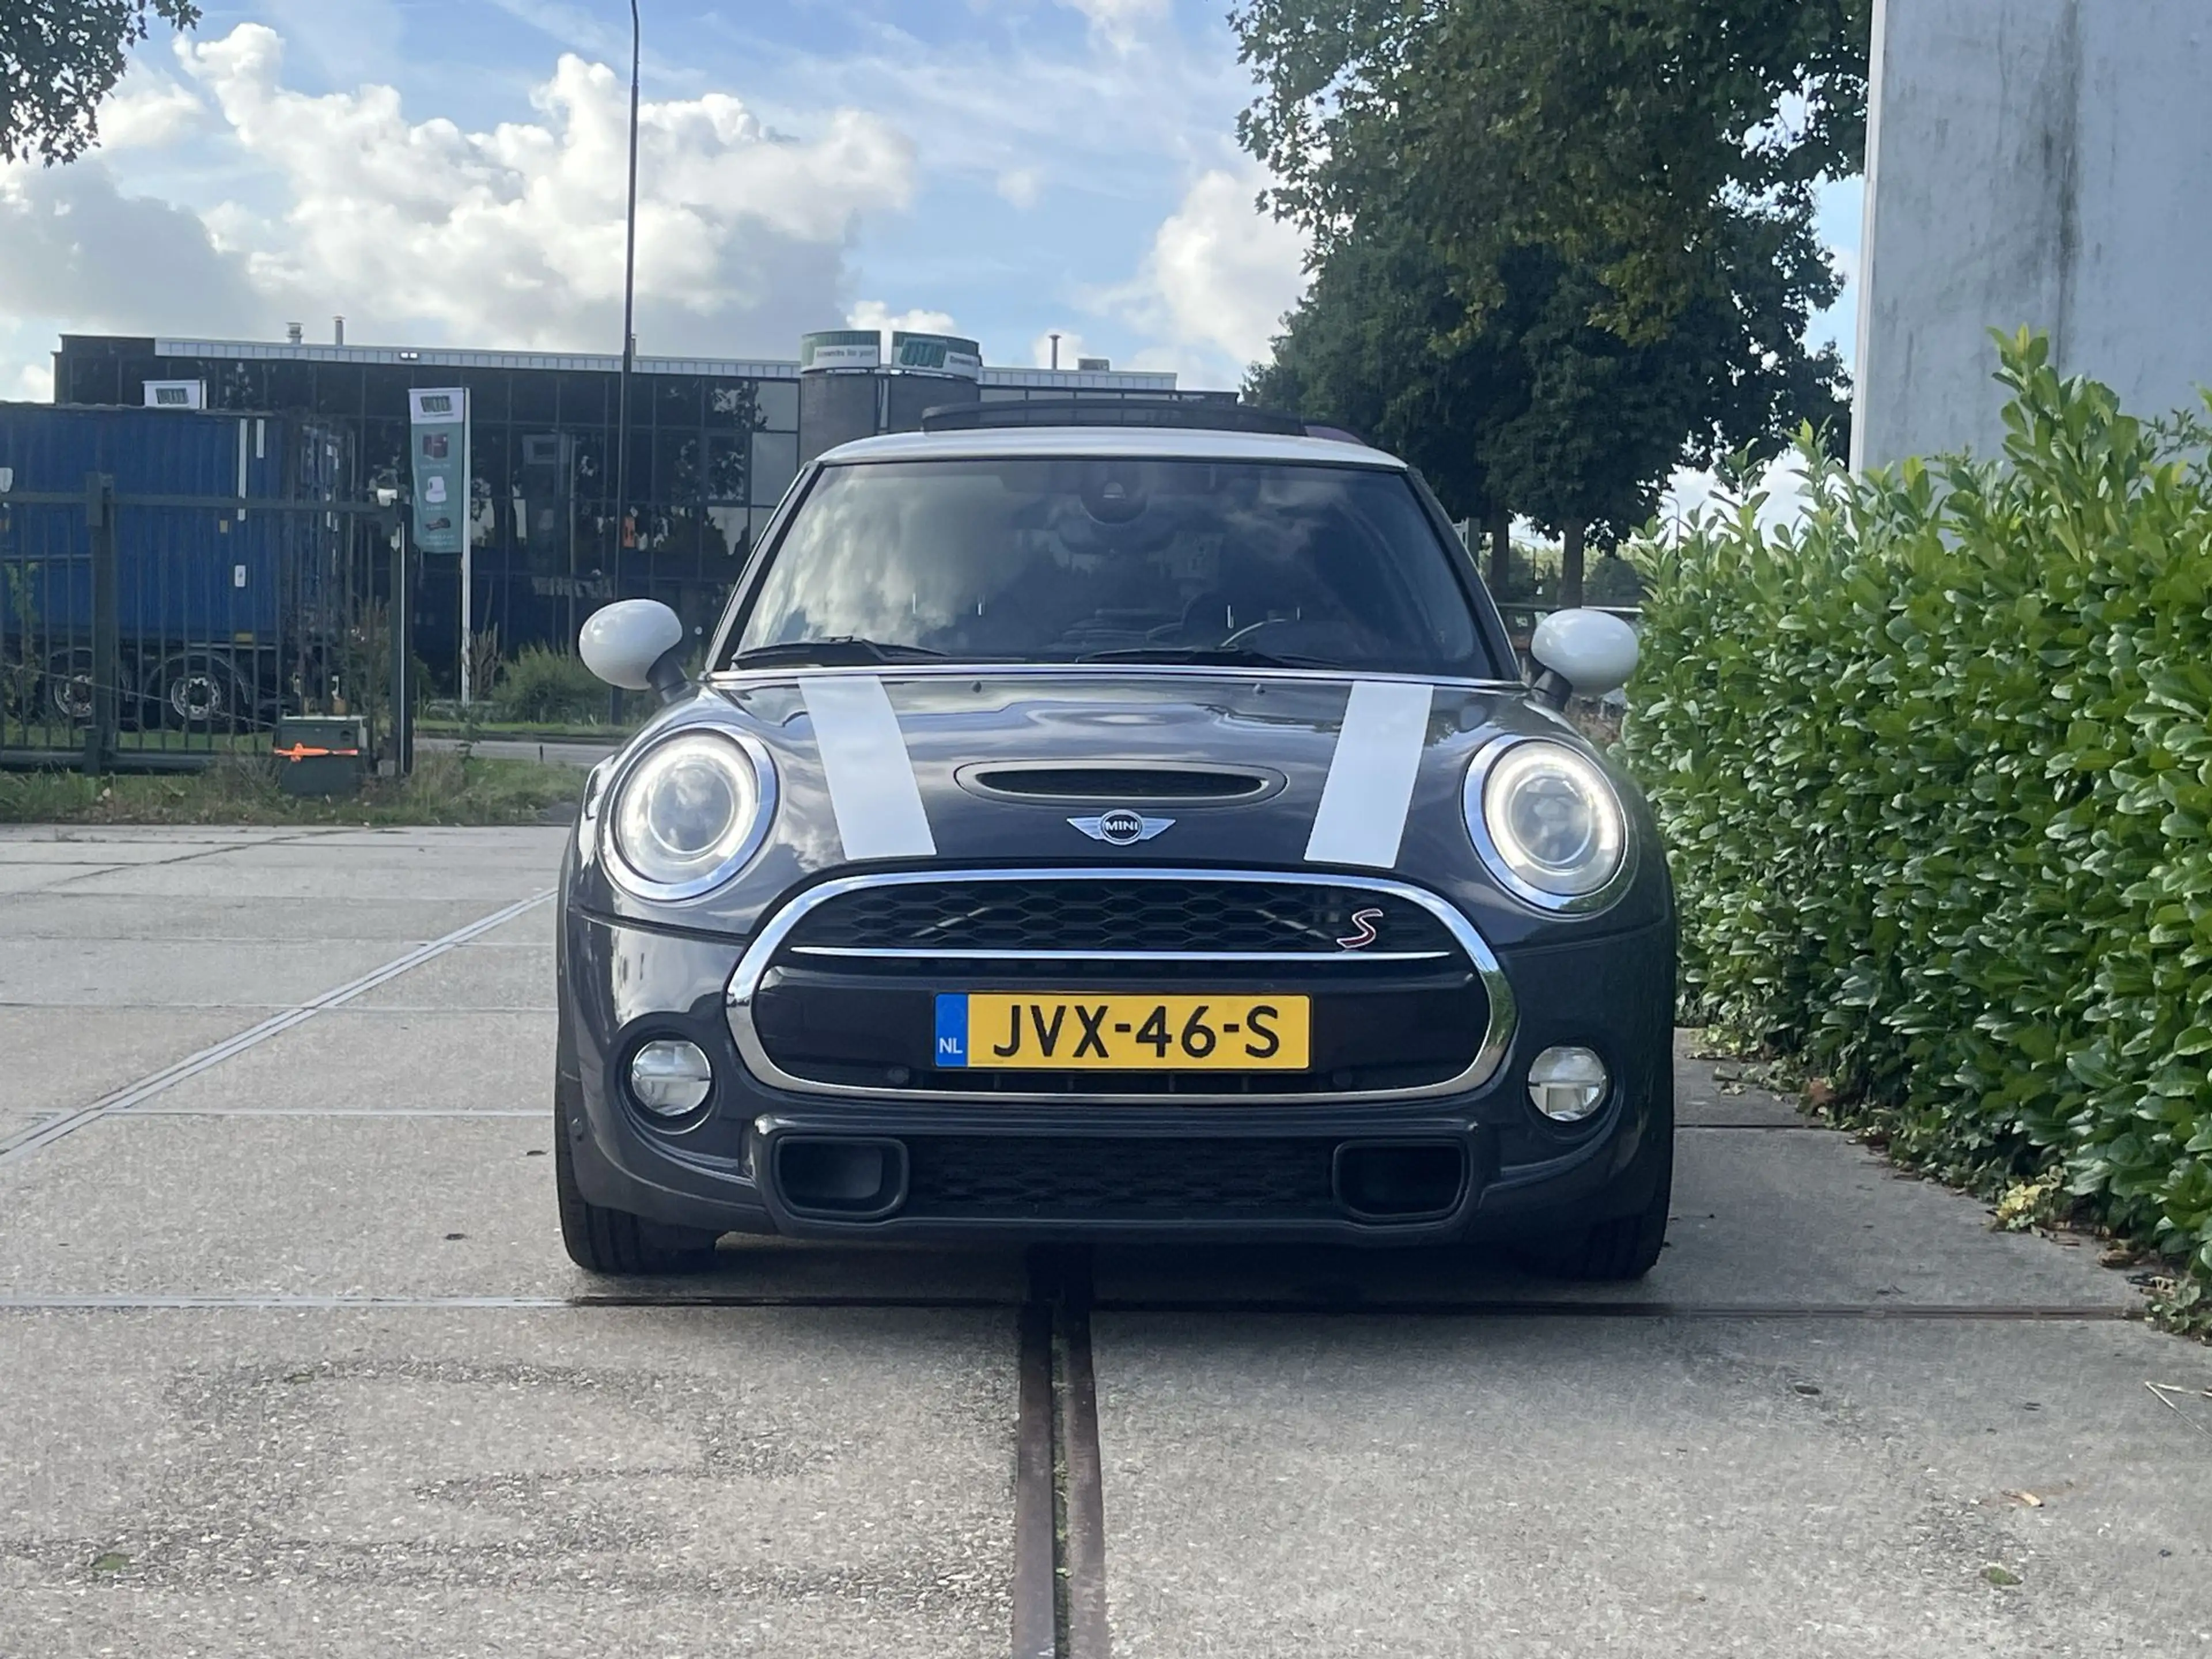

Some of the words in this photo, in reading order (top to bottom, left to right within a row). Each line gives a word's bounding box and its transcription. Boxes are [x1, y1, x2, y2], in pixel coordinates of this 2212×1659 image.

[1105, 820, 1138, 831] MINI
[1336, 908, 1384, 949] S
[939, 1037, 963, 1054] NL
[993, 1005, 1280, 1059] JVX-46-S
